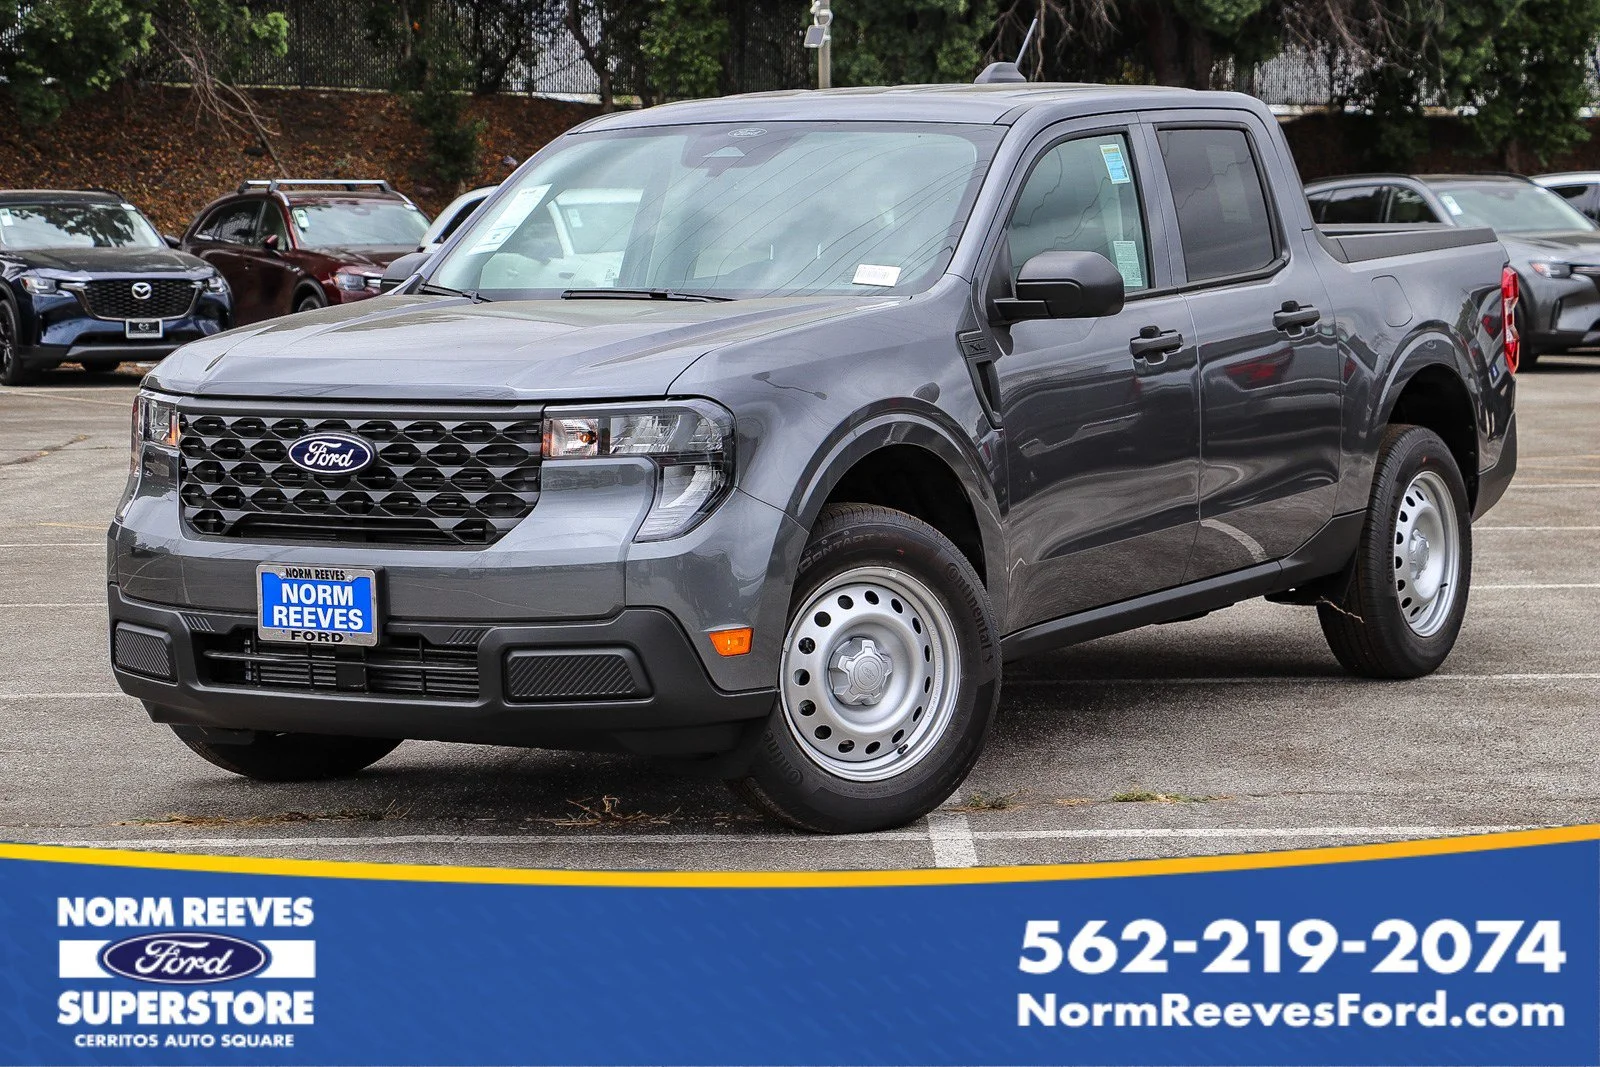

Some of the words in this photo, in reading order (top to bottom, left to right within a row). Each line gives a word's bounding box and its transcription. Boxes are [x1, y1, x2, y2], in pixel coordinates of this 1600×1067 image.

[969, 343, 987, 351] XL
[304, 441, 354, 467] Ford
[285, 568, 312, 579] NORM
[315, 569, 345, 580] REEVES
[281, 583, 354, 606] NORM
[946, 562, 993, 650] Continental
[273, 605, 364, 630] REEVES
[291, 631, 344, 643] FORD
